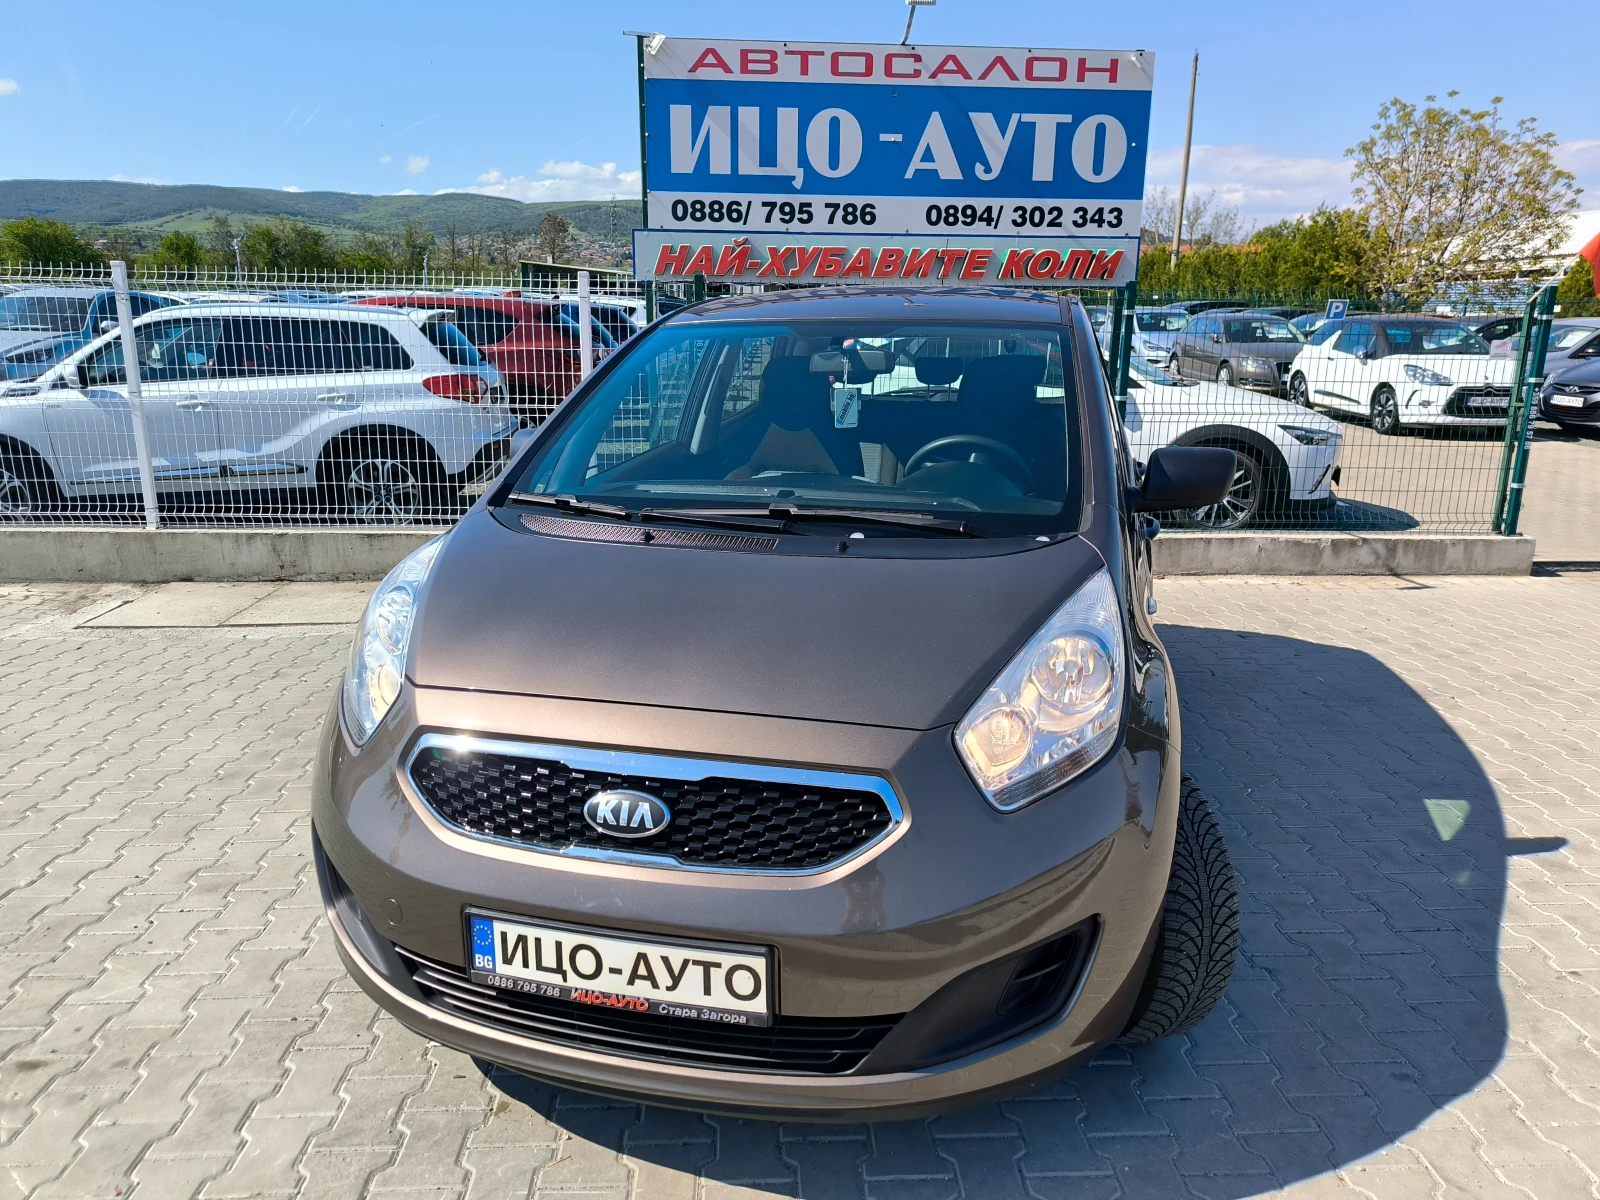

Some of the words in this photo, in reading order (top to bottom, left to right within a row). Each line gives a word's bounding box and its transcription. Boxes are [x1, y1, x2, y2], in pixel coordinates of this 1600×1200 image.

[688, 47, 1119, 83] АВТОСАЛОН
[671, 199, 751, 226] 0886/
[762, 201, 813, 225] 795
[826, 202, 877, 226] 786
[925, 204, 1004, 229] 0894/
[1012, 205, 1062, 228] 302
[1073, 206, 1123, 229] 343
[654, 237, 994, 279] НАЙ-ХУБАВИТЕ
[1000, 248, 1124, 280] КОЛИ
[1329, 302, 1344, 318] P
[1532, 387, 1540, 405] +359
[1529, 406, 1537, 419] 886
[1526, 431, 1533, 439] 57
[1527, 421, 1535, 430] 79
[596, 799, 654, 829] KIA
[474, 953, 493, 970] BG
[500, 931, 762, 1002] ИЦО-АУТО
[487, 976, 514, 989] 0886
[517, 981, 538, 993] 795
[540, 984, 560, 997] 786
[570, 988, 649, 1011] ИЦО-АУТО
[658, 1004, 698, 1019] Стара
[701, 1009, 748, 1025] Загора
